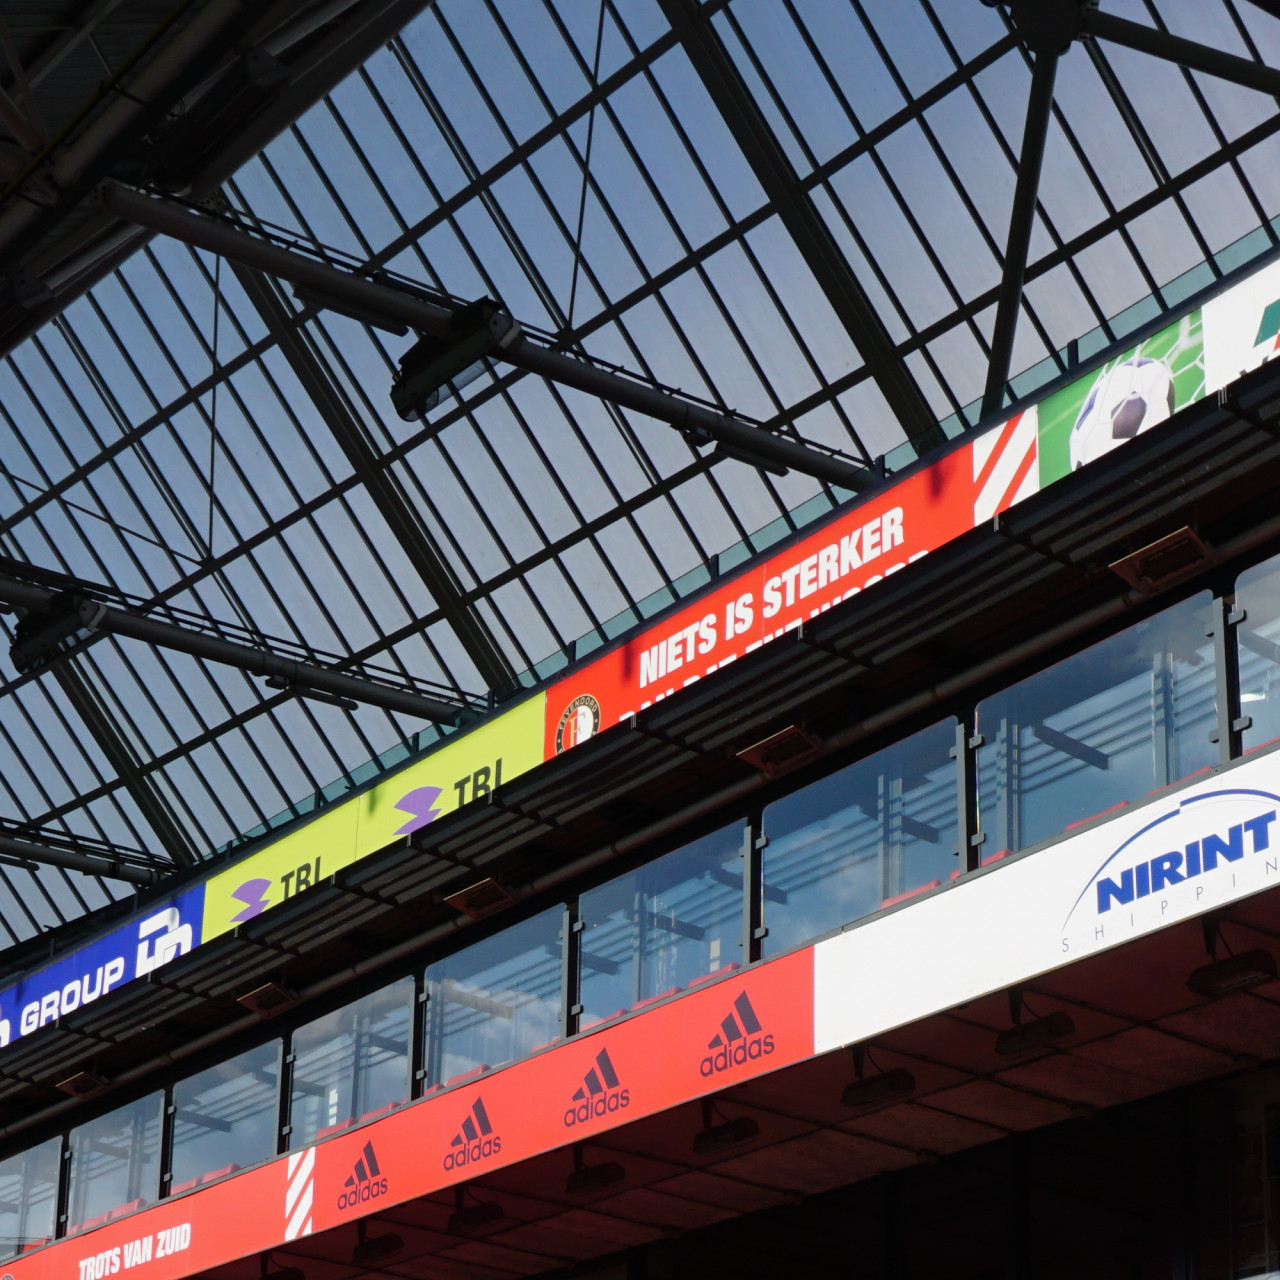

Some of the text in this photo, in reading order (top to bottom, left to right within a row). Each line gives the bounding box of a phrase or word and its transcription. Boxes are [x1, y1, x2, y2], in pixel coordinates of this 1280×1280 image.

[639, 613, 718, 689] NIETS
[724, 592, 755, 642] IS
[761, 505, 905, 618] STERKER
[1096, 809, 1277, 915] NIRINT
[20, 957, 125, 1036] GROUP
[700, 1030, 776, 1078] adidas
[563, 1085, 630, 1128] adidas
[443, 1134, 502, 1172] adidas
[337, 1175, 388, 1211] adidas
[123, 1235, 152, 1270] VAN
[156, 1223, 192, 1259] ZUID
